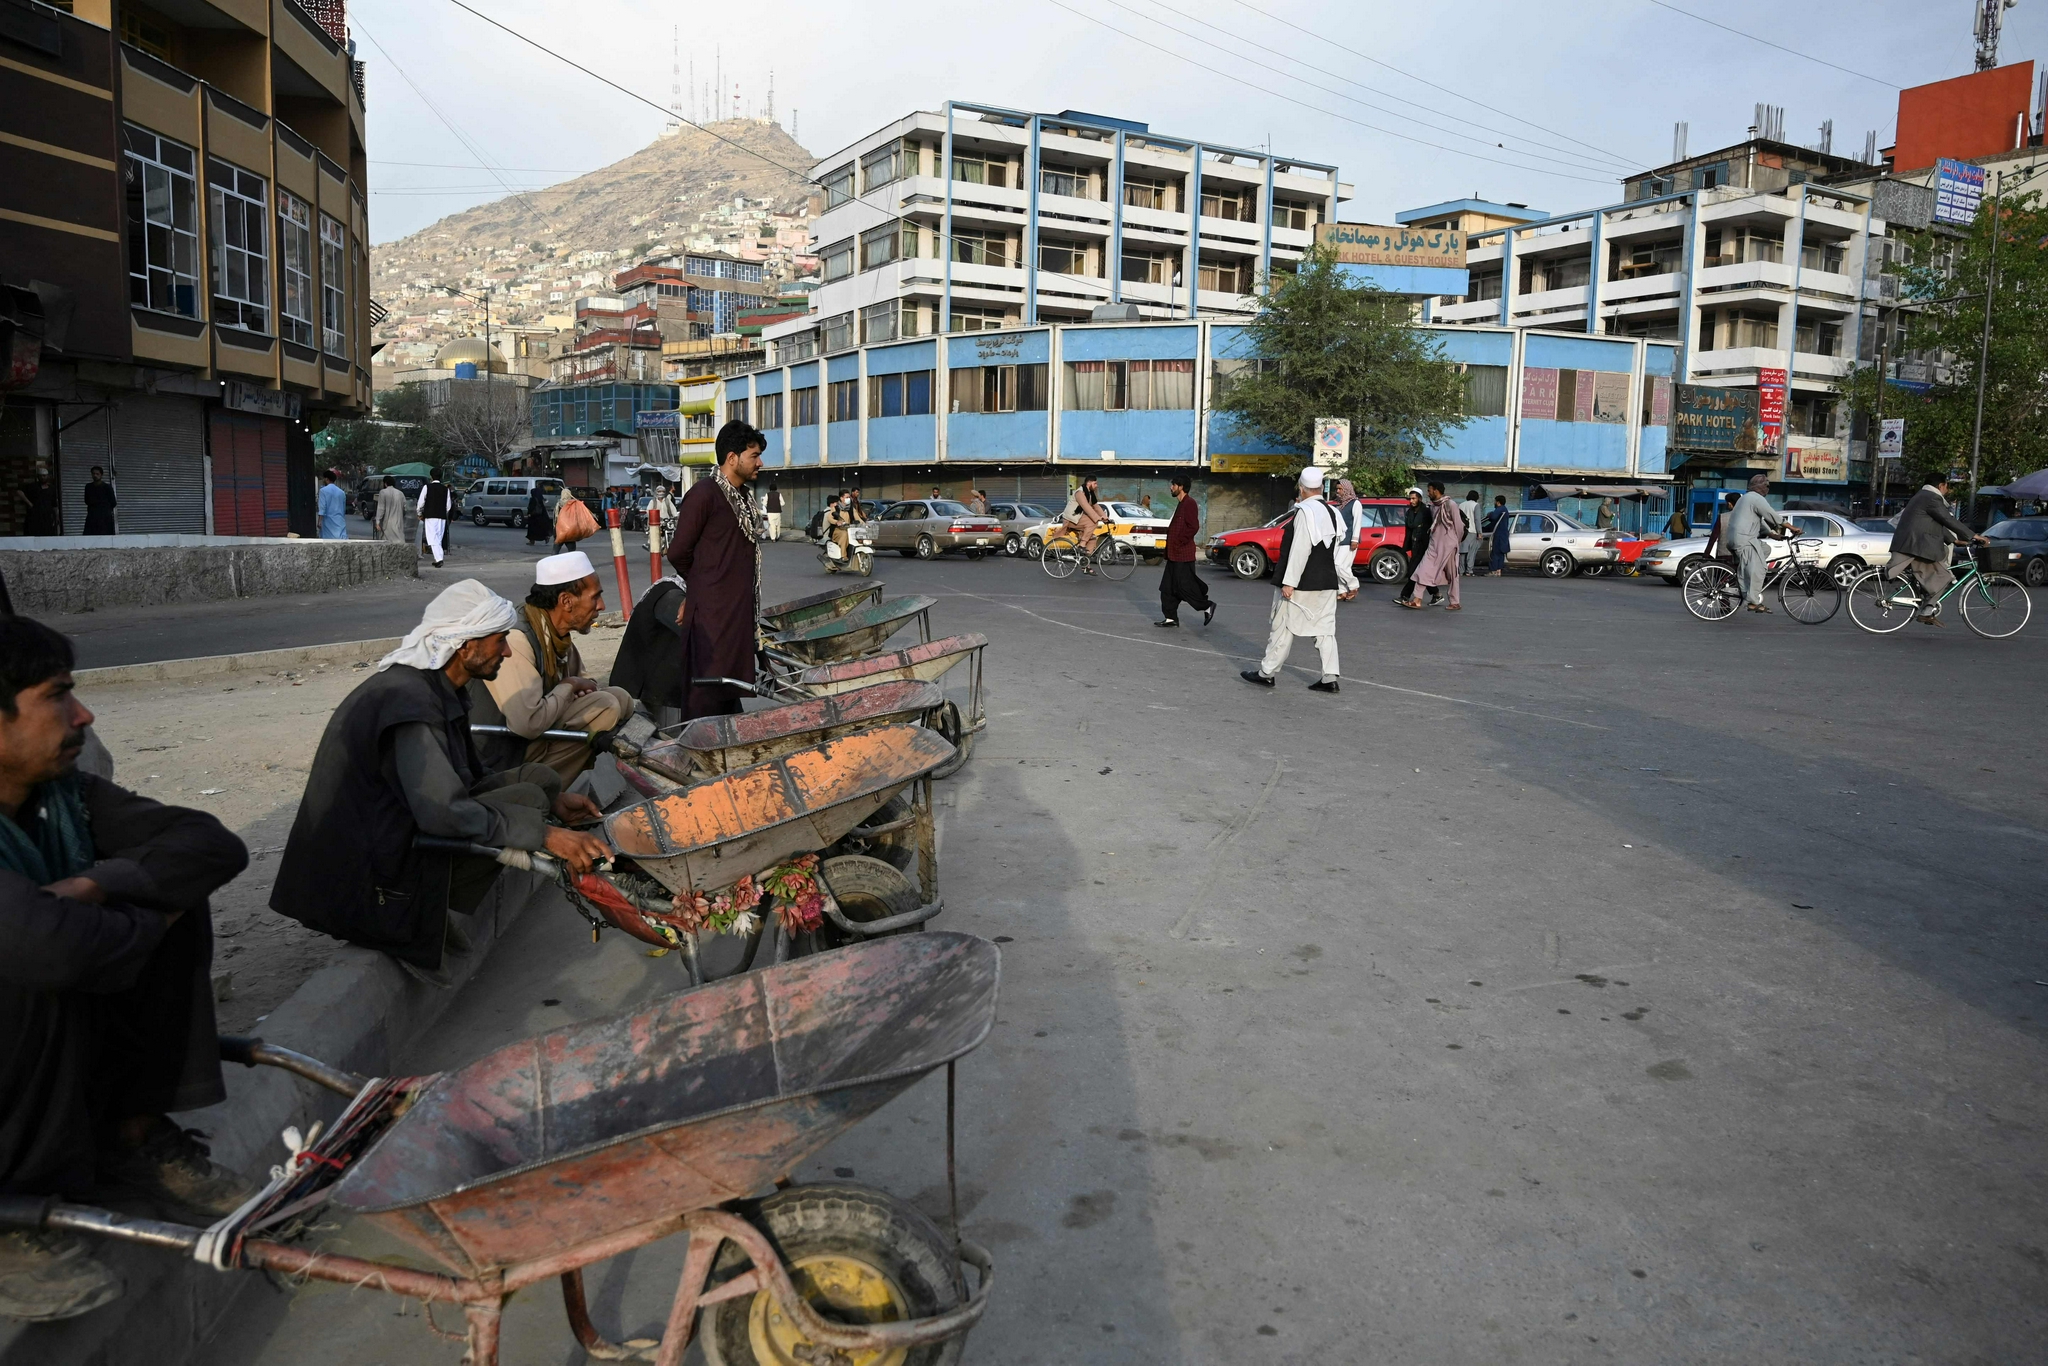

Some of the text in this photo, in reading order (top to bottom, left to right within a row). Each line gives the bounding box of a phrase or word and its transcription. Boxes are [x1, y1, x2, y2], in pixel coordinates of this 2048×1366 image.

[1383, 237, 1391, 251] و
[1394, 231, 1424, 252] هوتل
[1428, 233, 1459, 255] پارک
[1352, 252, 1382, 262] HOTEL
[1385, 254, 1391, 262] &
[1395, 254, 1425, 264] GUEST
[1427, 256, 1459, 266] HOUSE
[1714, 396, 1720, 410] و
[1677, 412, 1737, 429] PARK HOTEL
[1821, 452, 1839, 465] فروشگاه
[1822, 467, 1838, 475] Store
